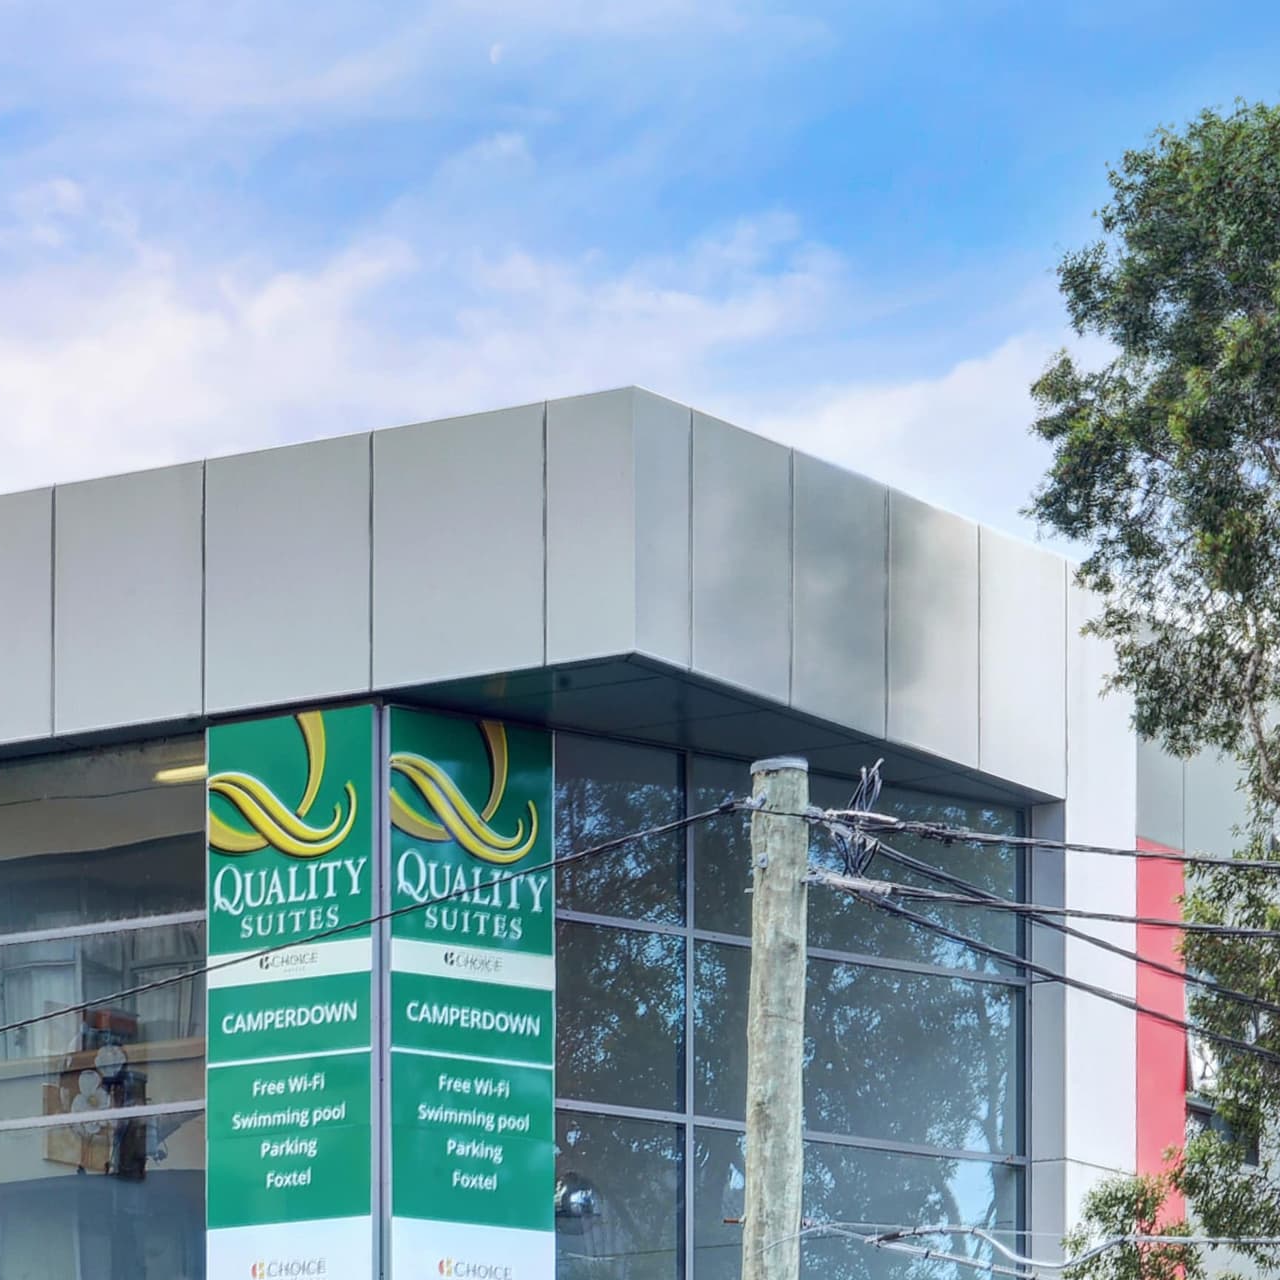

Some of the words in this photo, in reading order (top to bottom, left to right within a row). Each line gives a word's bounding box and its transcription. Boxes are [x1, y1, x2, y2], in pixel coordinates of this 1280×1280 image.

[213, 857, 367, 916] QUALITY
[396, 848, 548, 914] QUALITY
[240, 904, 339, 939] SUITES
[425, 906, 523, 940] SUITES
[221, 1000, 359, 1035] CAMPERDOWN
[406, 1000, 541, 1037] CAMPERDOWN
[252, 1078, 285, 1097] Free
[288, 1072, 326, 1093] Wi-Fi
[438, 1074, 471, 1093] Free
[232, 1107, 310, 1131] Swimming
[312, 1101, 346, 1126] pool
[417, 1104, 495, 1132] Swimming
[497, 1113, 531, 1133] pool
[260, 1137, 318, 1159] Parking
[446, 1138, 504, 1164] Parking
[265, 1167, 312, 1189] Foxtel
[452, 1170, 498, 1191] Foxtel
[266, 1258, 327, 1278] CHOICE
[454, 1262, 513, 1280] CHOICE
